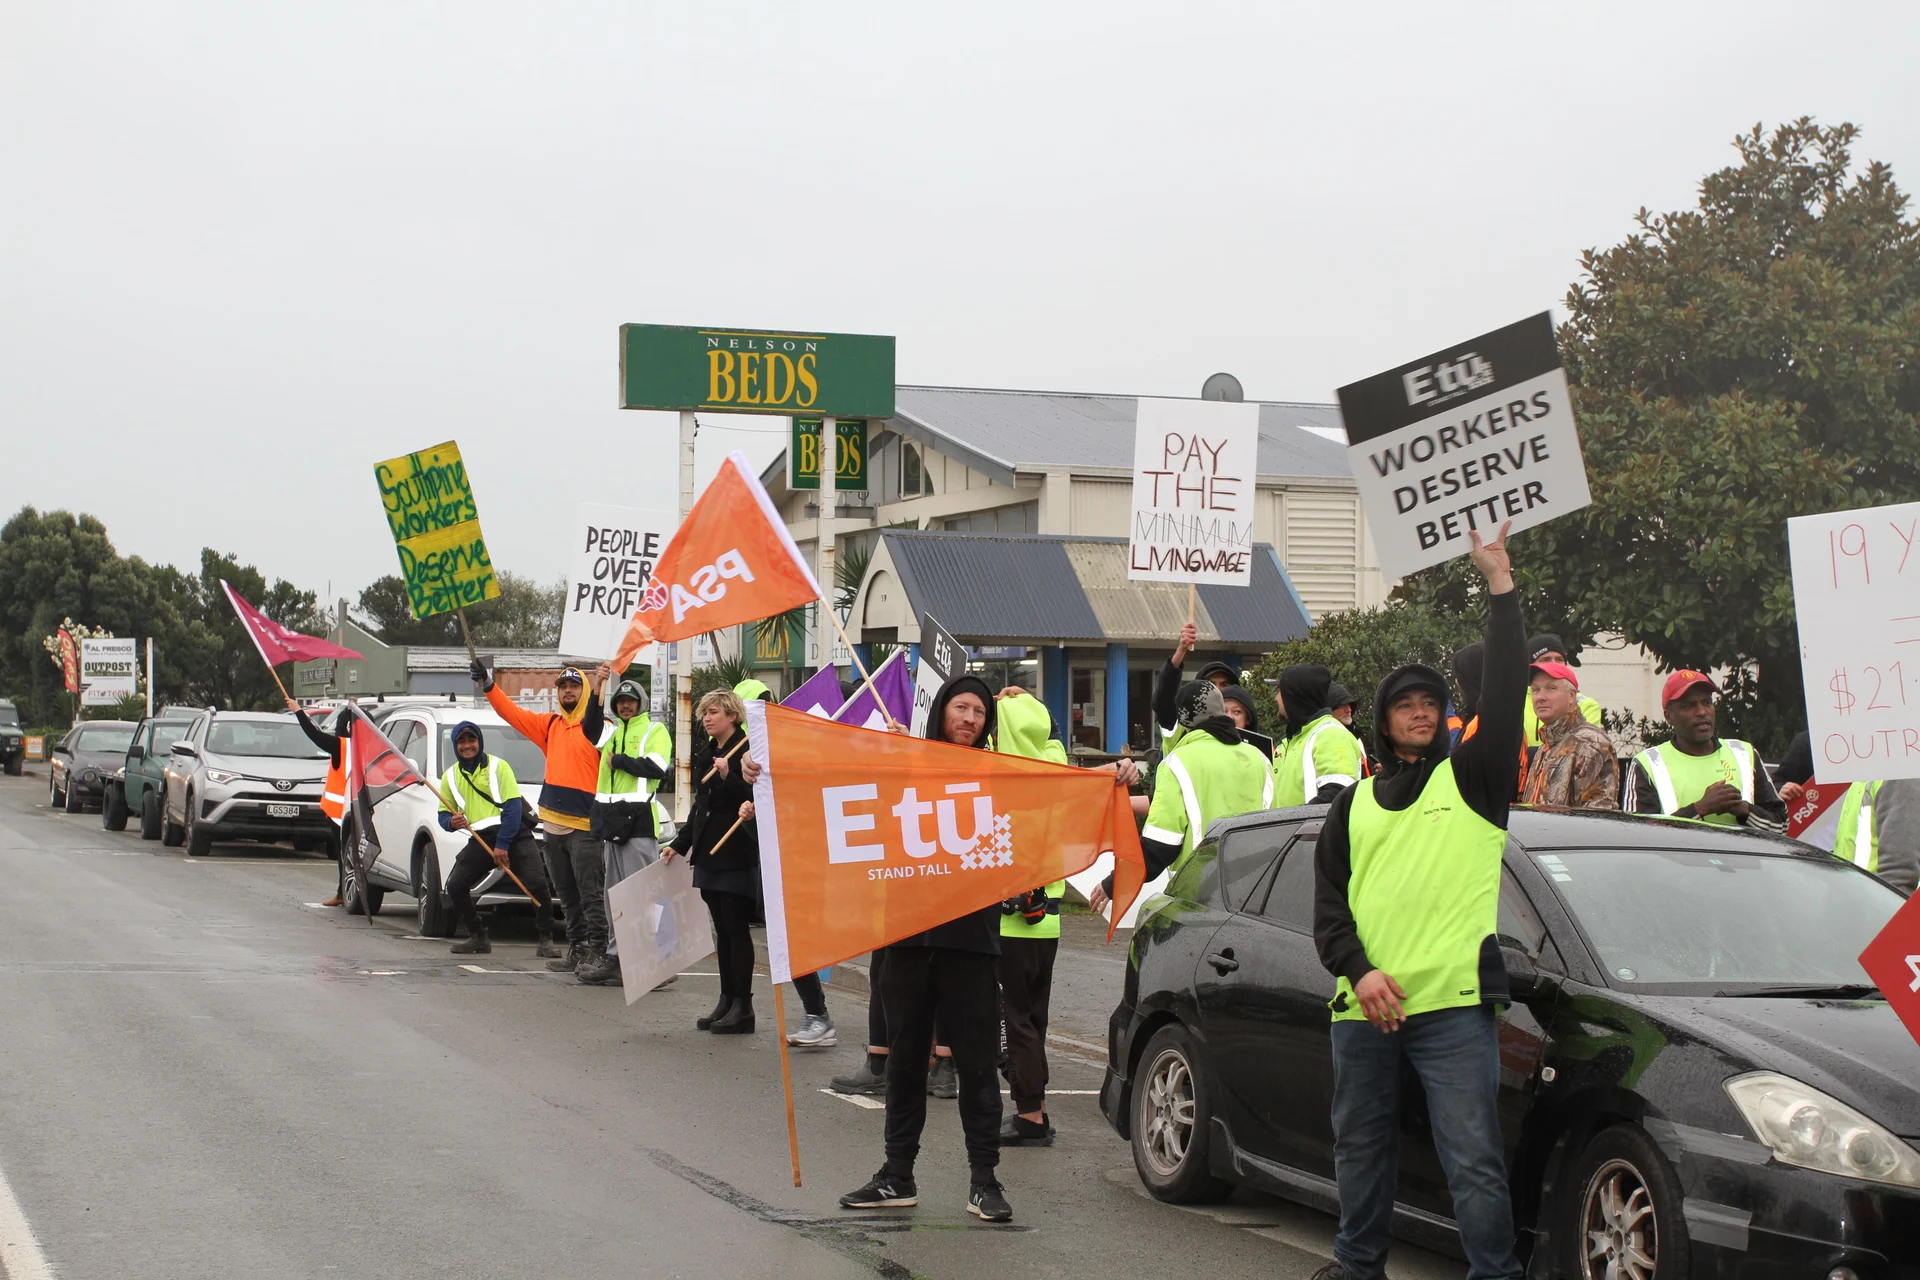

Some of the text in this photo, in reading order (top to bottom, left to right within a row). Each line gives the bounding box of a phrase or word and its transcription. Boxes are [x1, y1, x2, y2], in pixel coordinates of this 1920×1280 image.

[707, 338, 817, 351] NELSON
[706, 349, 818, 407] BEDS
[1164, 432, 1228, 475] PAY
[1369, 390, 1551, 478] WORKERS
[1142, 470, 1242, 511] THE
[1393, 434, 1550, 515] DESERVE
[1135, 511, 1252, 548] MINIMUM
[1416, 480, 1549, 550] BETTER
[585, 526, 660, 558] PEOPLE
[1830, 524, 1870, 589] 19
[593, 557, 652, 588] OVER
[408, 572, 492, 619] Better
[84, 662, 132, 672] OUTPOST
[267, 806, 298, 815] LGS384
[1793, 802, 1818, 824] PSA
[868, 863, 951, 880] STAND TALL
